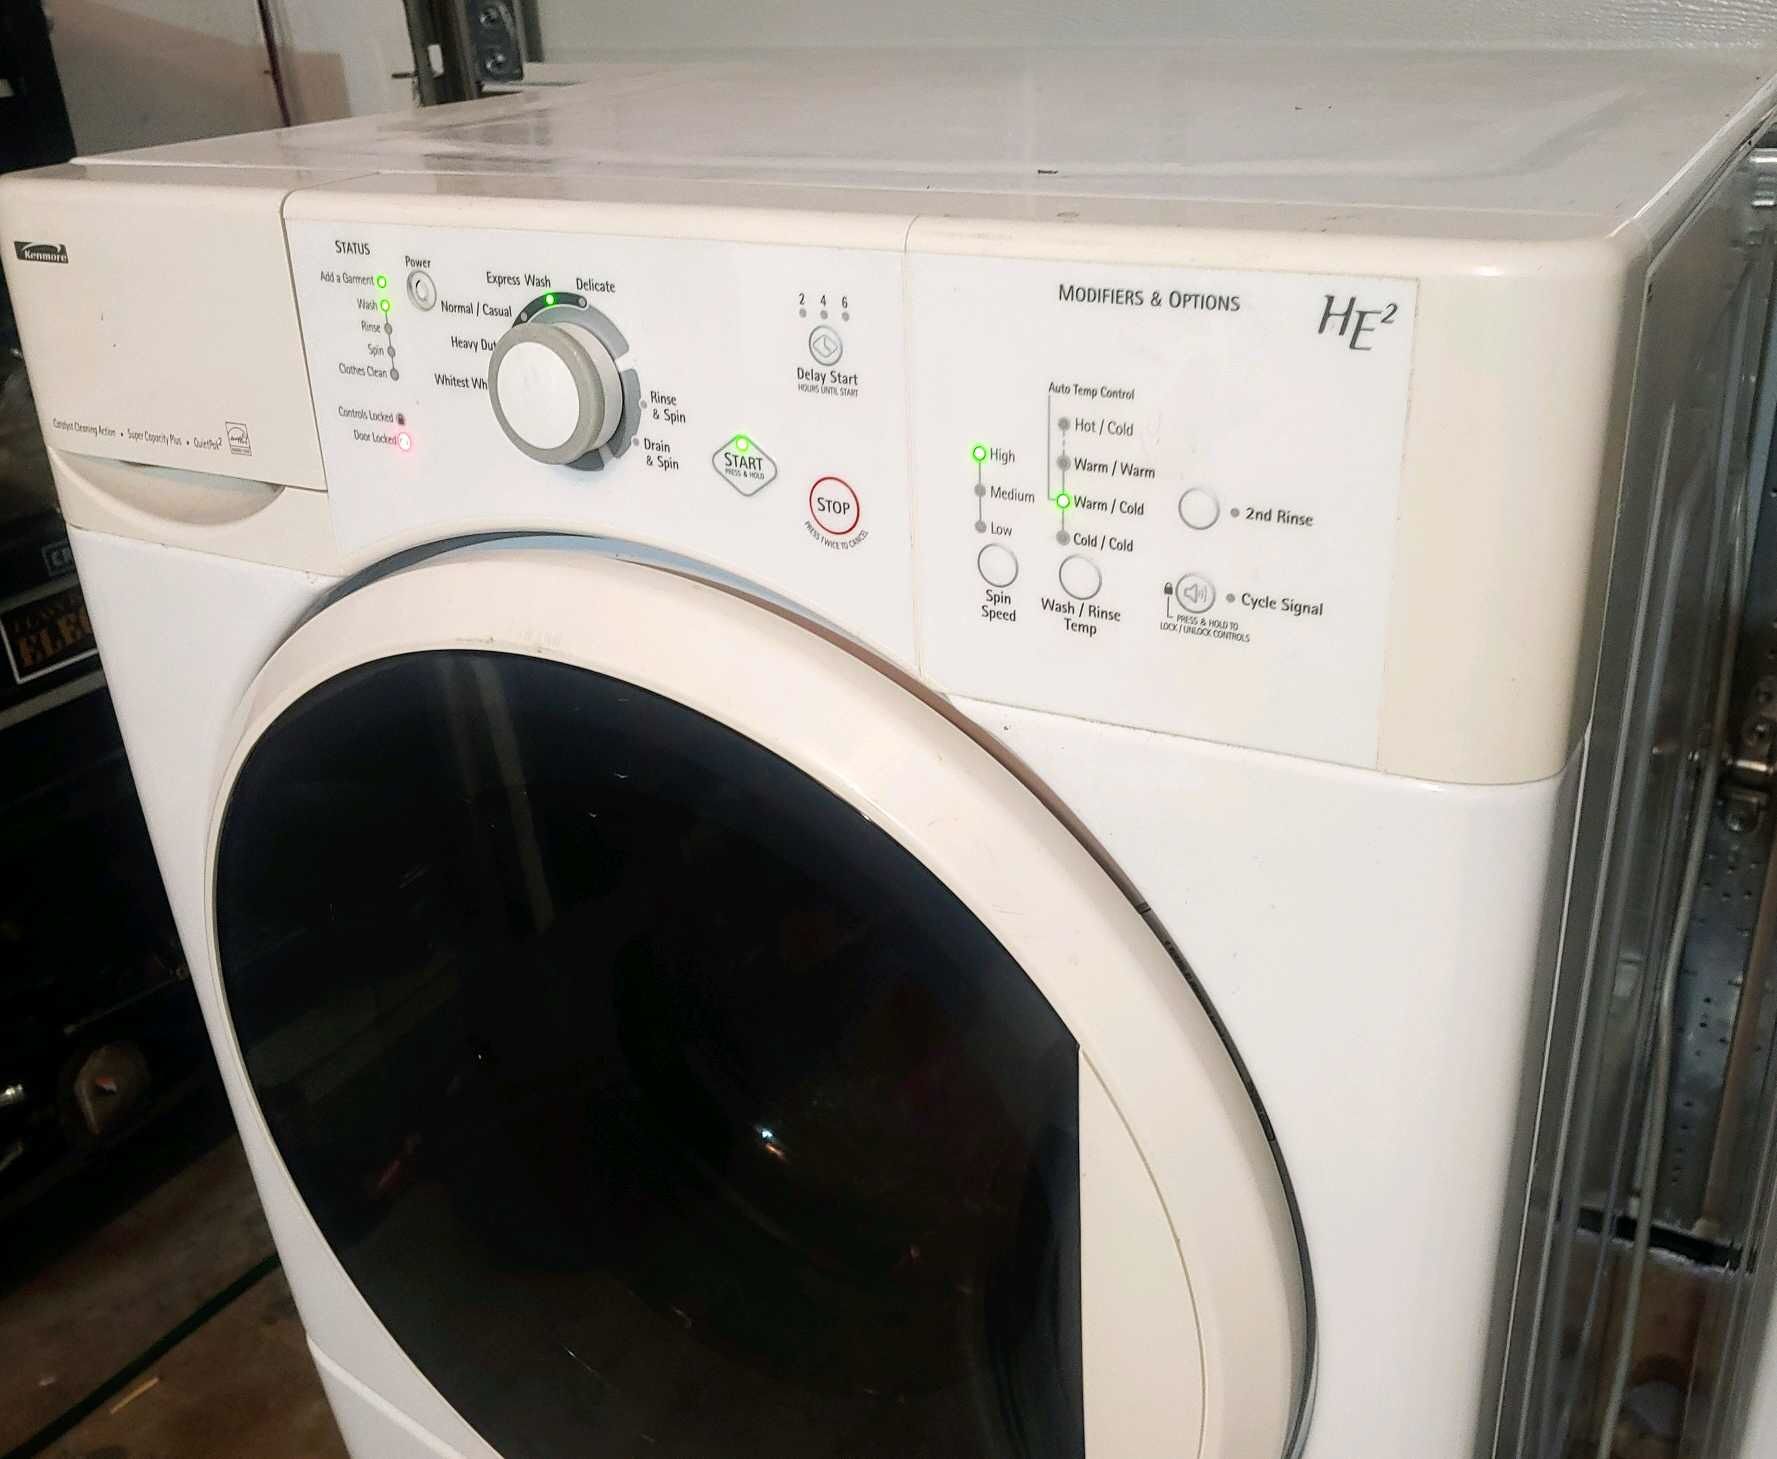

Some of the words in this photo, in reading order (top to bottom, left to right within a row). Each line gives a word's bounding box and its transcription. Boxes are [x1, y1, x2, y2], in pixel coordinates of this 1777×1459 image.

[24, 249, 69, 262] Kenmore
[335, 240, 371, 256] STATUS
[405, 255, 431, 269] Power
[320, 271, 335, 283] Add
[342, 272, 374, 286] Garment
[486, 271, 521, 288] Express
[524, 274, 551, 289] Wash
[576, 278, 616, 293] Delicate
[357, 299, 378, 311] Wash
[799, 293, 805, 306] 2
[820, 295, 827, 307] 4
[842, 297, 848, 309] 6
[1058, 284, 1144, 307] MODIFIERS
[1151, 290, 1162, 307] &
[1168, 290, 1241, 312] OPTIONS
[441, 301, 474, 315] Normal
[482, 304, 512, 318] Casual
[361, 321, 381, 333] Rinse
[368, 343, 384, 358] Spin
[451, 336, 479, 353] Heavy
[481, 339, 497, 352] Dut
[339, 363, 365, 377] Clothes
[367, 366, 388, 379] Clean
[797, 367, 826, 386] Delay
[830, 370, 859, 386] Start
[434, 373, 470, 389] Whitest
[650, 390, 677, 406] Rinse
[798, 383, 819, 393] HOURS
[820, 386, 839, 396] UNTIL
[839, 387, 858, 398] START
[1048, 382, 1071, 395] Auto
[1073, 384, 1097, 400] Temp
[1100, 386, 1135, 401] Control
[338, 405, 368, 420] Controls
[369, 409, 394, 423] Locked
[652, 409, 660, 420] &
[664, 409, 686, 424] Spin
[1075, 417, 1095, 433] Hot
[1099, 418, 1105, 436] /
[1107, 420, 1133, 437] Cold
[354, 429, 371, 442] Door
[372, 432, 397, 445] Locked
[644, 438, 670, 453] Drain
[646, 456, 654, 466] &
[657, 456, 679, 471] Spin
[724, 452, 763, 471] START
[990, 448, 1016, 465] High
[725, 468, 741, 477] PRESS
[749, 471, 765, 480] HOLD
[1074, 458, 1108, 474] Warm
[1112, 460, 1117, 477] /
[1120, 462, 1156, 479] Warm
[990, 486, 1035, 504] Medium
[817, 497, 851, 516] STOP
[1073, 496, 1108, 512] Warm
[1111, 498, 1116, 515] /
[1119, 499, 1145, 516] Cold
[1245, 507, 1272, 522] 2nd
[1277, 509, 1314, 527] Rinse
[804, 520, 820, 540] PRESS
[820, 535, 840, 550] TWICE
[848, 530, 869, 548] CANCEL
[991, 521, 1012, 537] Low
[1073, 533, 1097, 549] Cold
[1101, 535, 1106, 551] /
[1109, 536, 1134, 552] Cold
[985, 589, 1011, 607] Spin
[1241, 592, 1277, 610] Cycle
[1281, 597, 1324, 617] Signal
[981, 605, 1017, 622] Speed
[1041, 598, 1075, 615] Wash
[1079, 602, 1085, 618] /
[1088, 603, 1121, 622] Rinse
[1064, 618, 1097, 637] Temp
[1177, 614, 1198, 626] PRESS
[1208, 619, 1228, 630] HOLD
[1229, 621, 1239, 631] TO
[1160, 622, 1177, 632] LOCK
[1183, 625, 1211, 637] UNLOCK
[1213, 629, 1250, 642] CONTROLS
